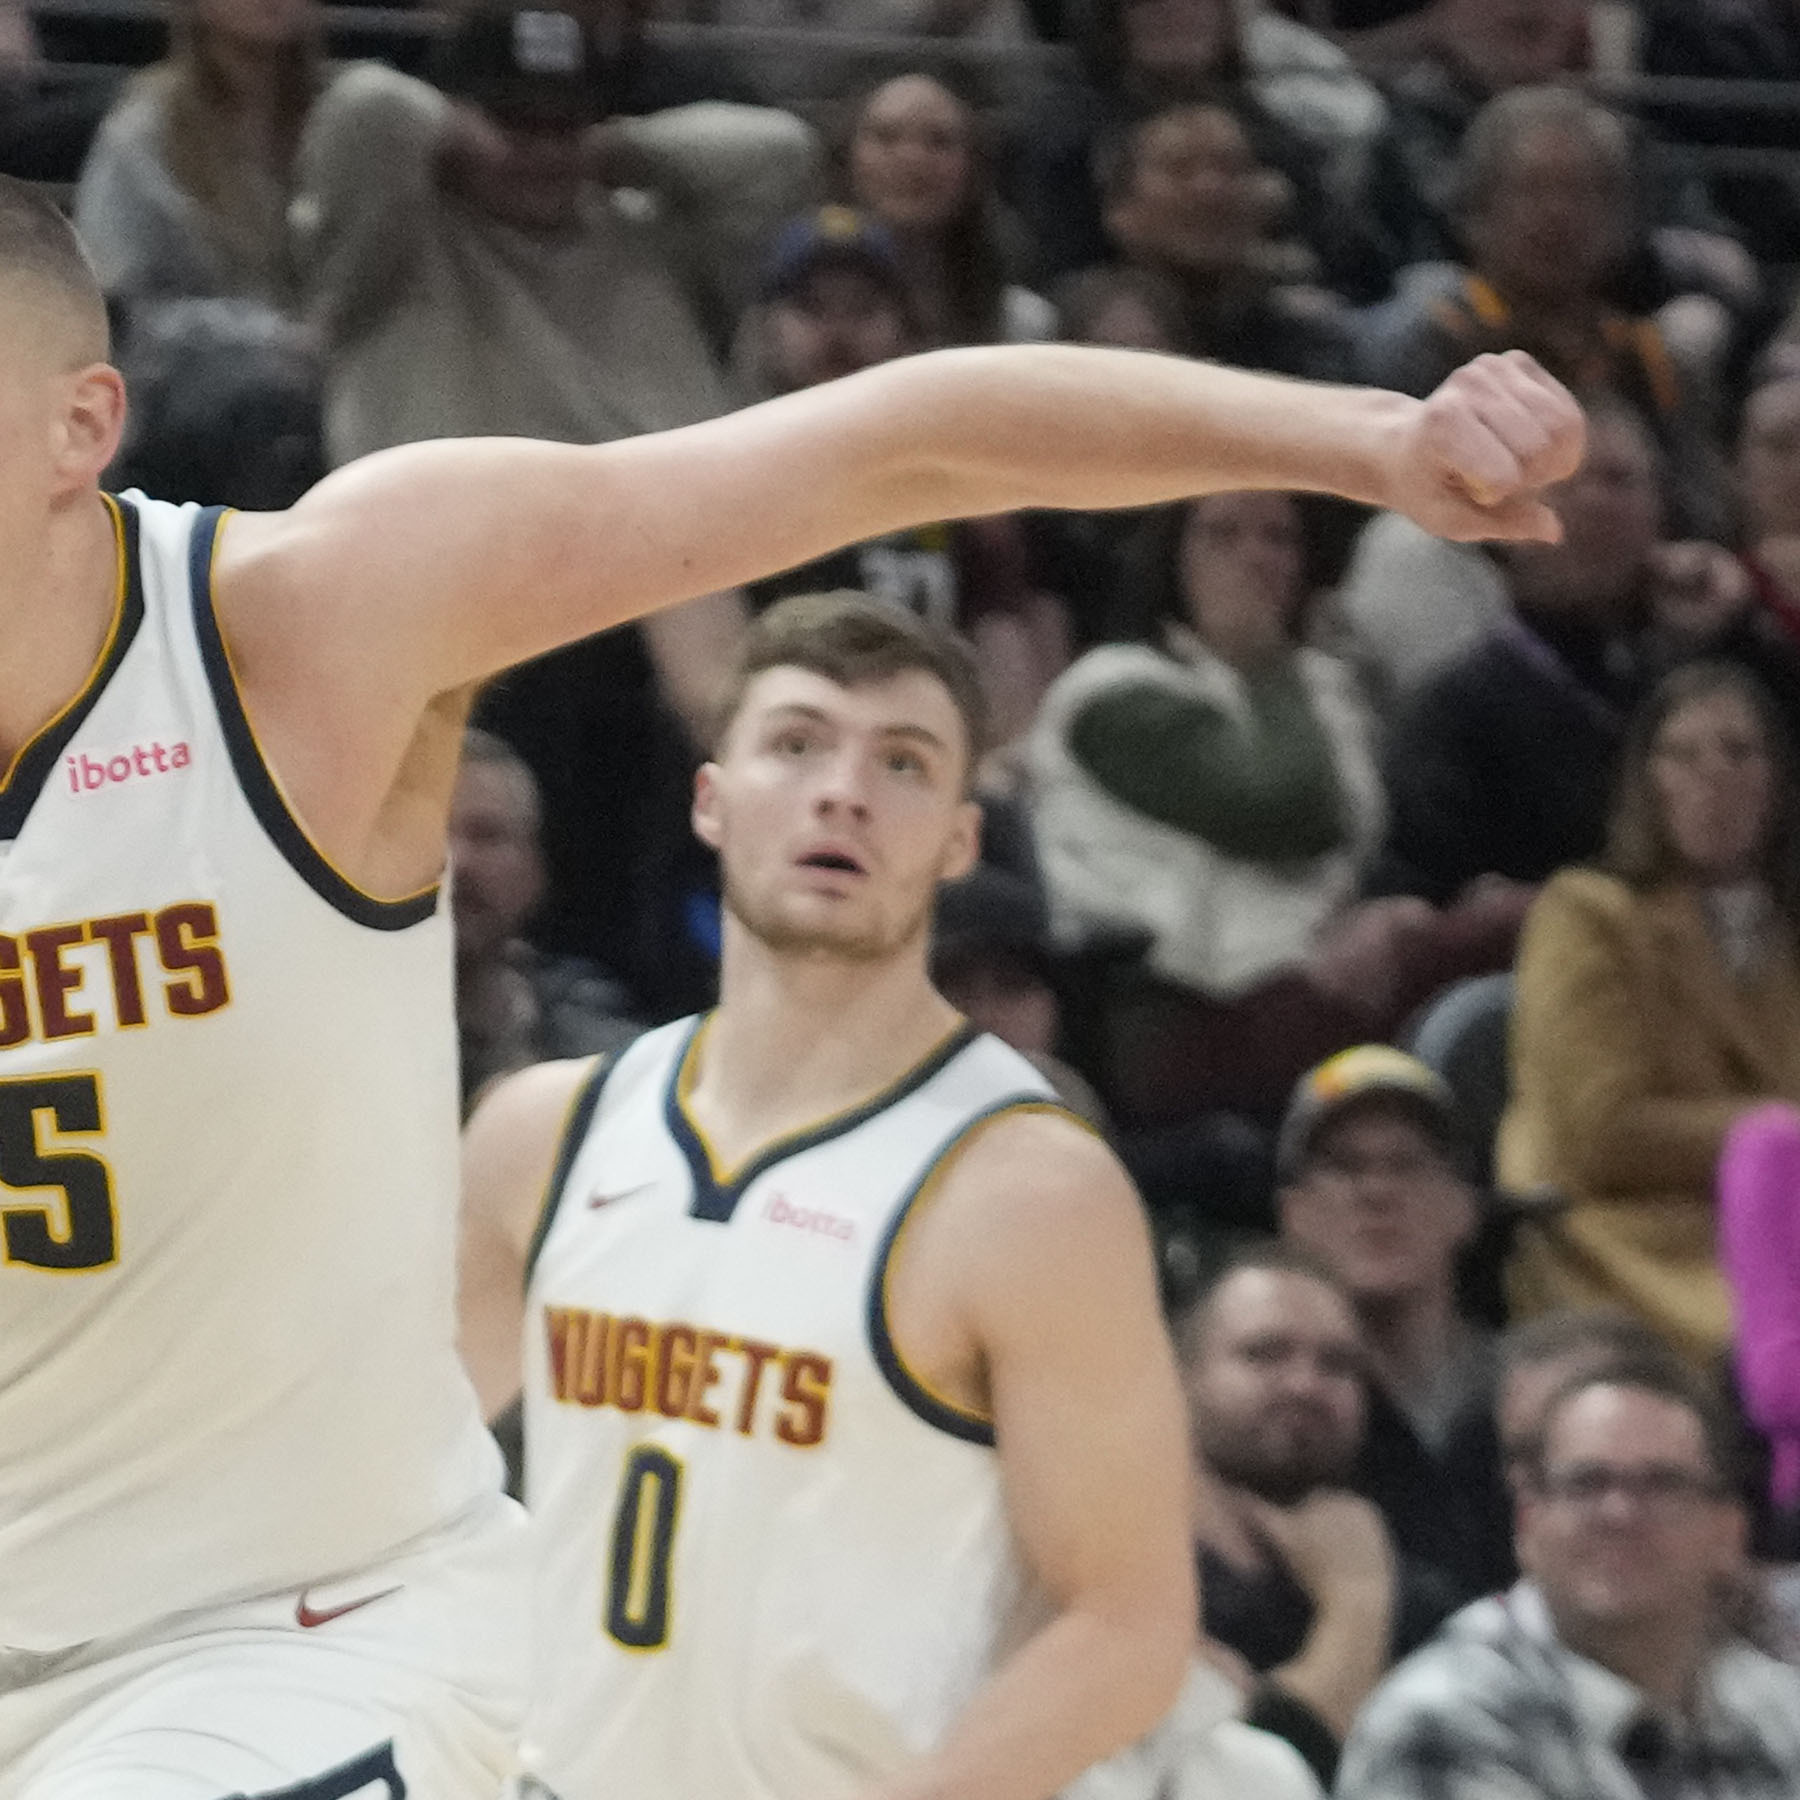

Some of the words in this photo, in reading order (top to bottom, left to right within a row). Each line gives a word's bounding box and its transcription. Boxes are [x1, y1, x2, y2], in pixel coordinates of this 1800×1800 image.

[66, 741, 193, 793] ibotta
[544, 1304, 835, 1450] NUGGETS
[604, 1441, 684, 1656] 0
